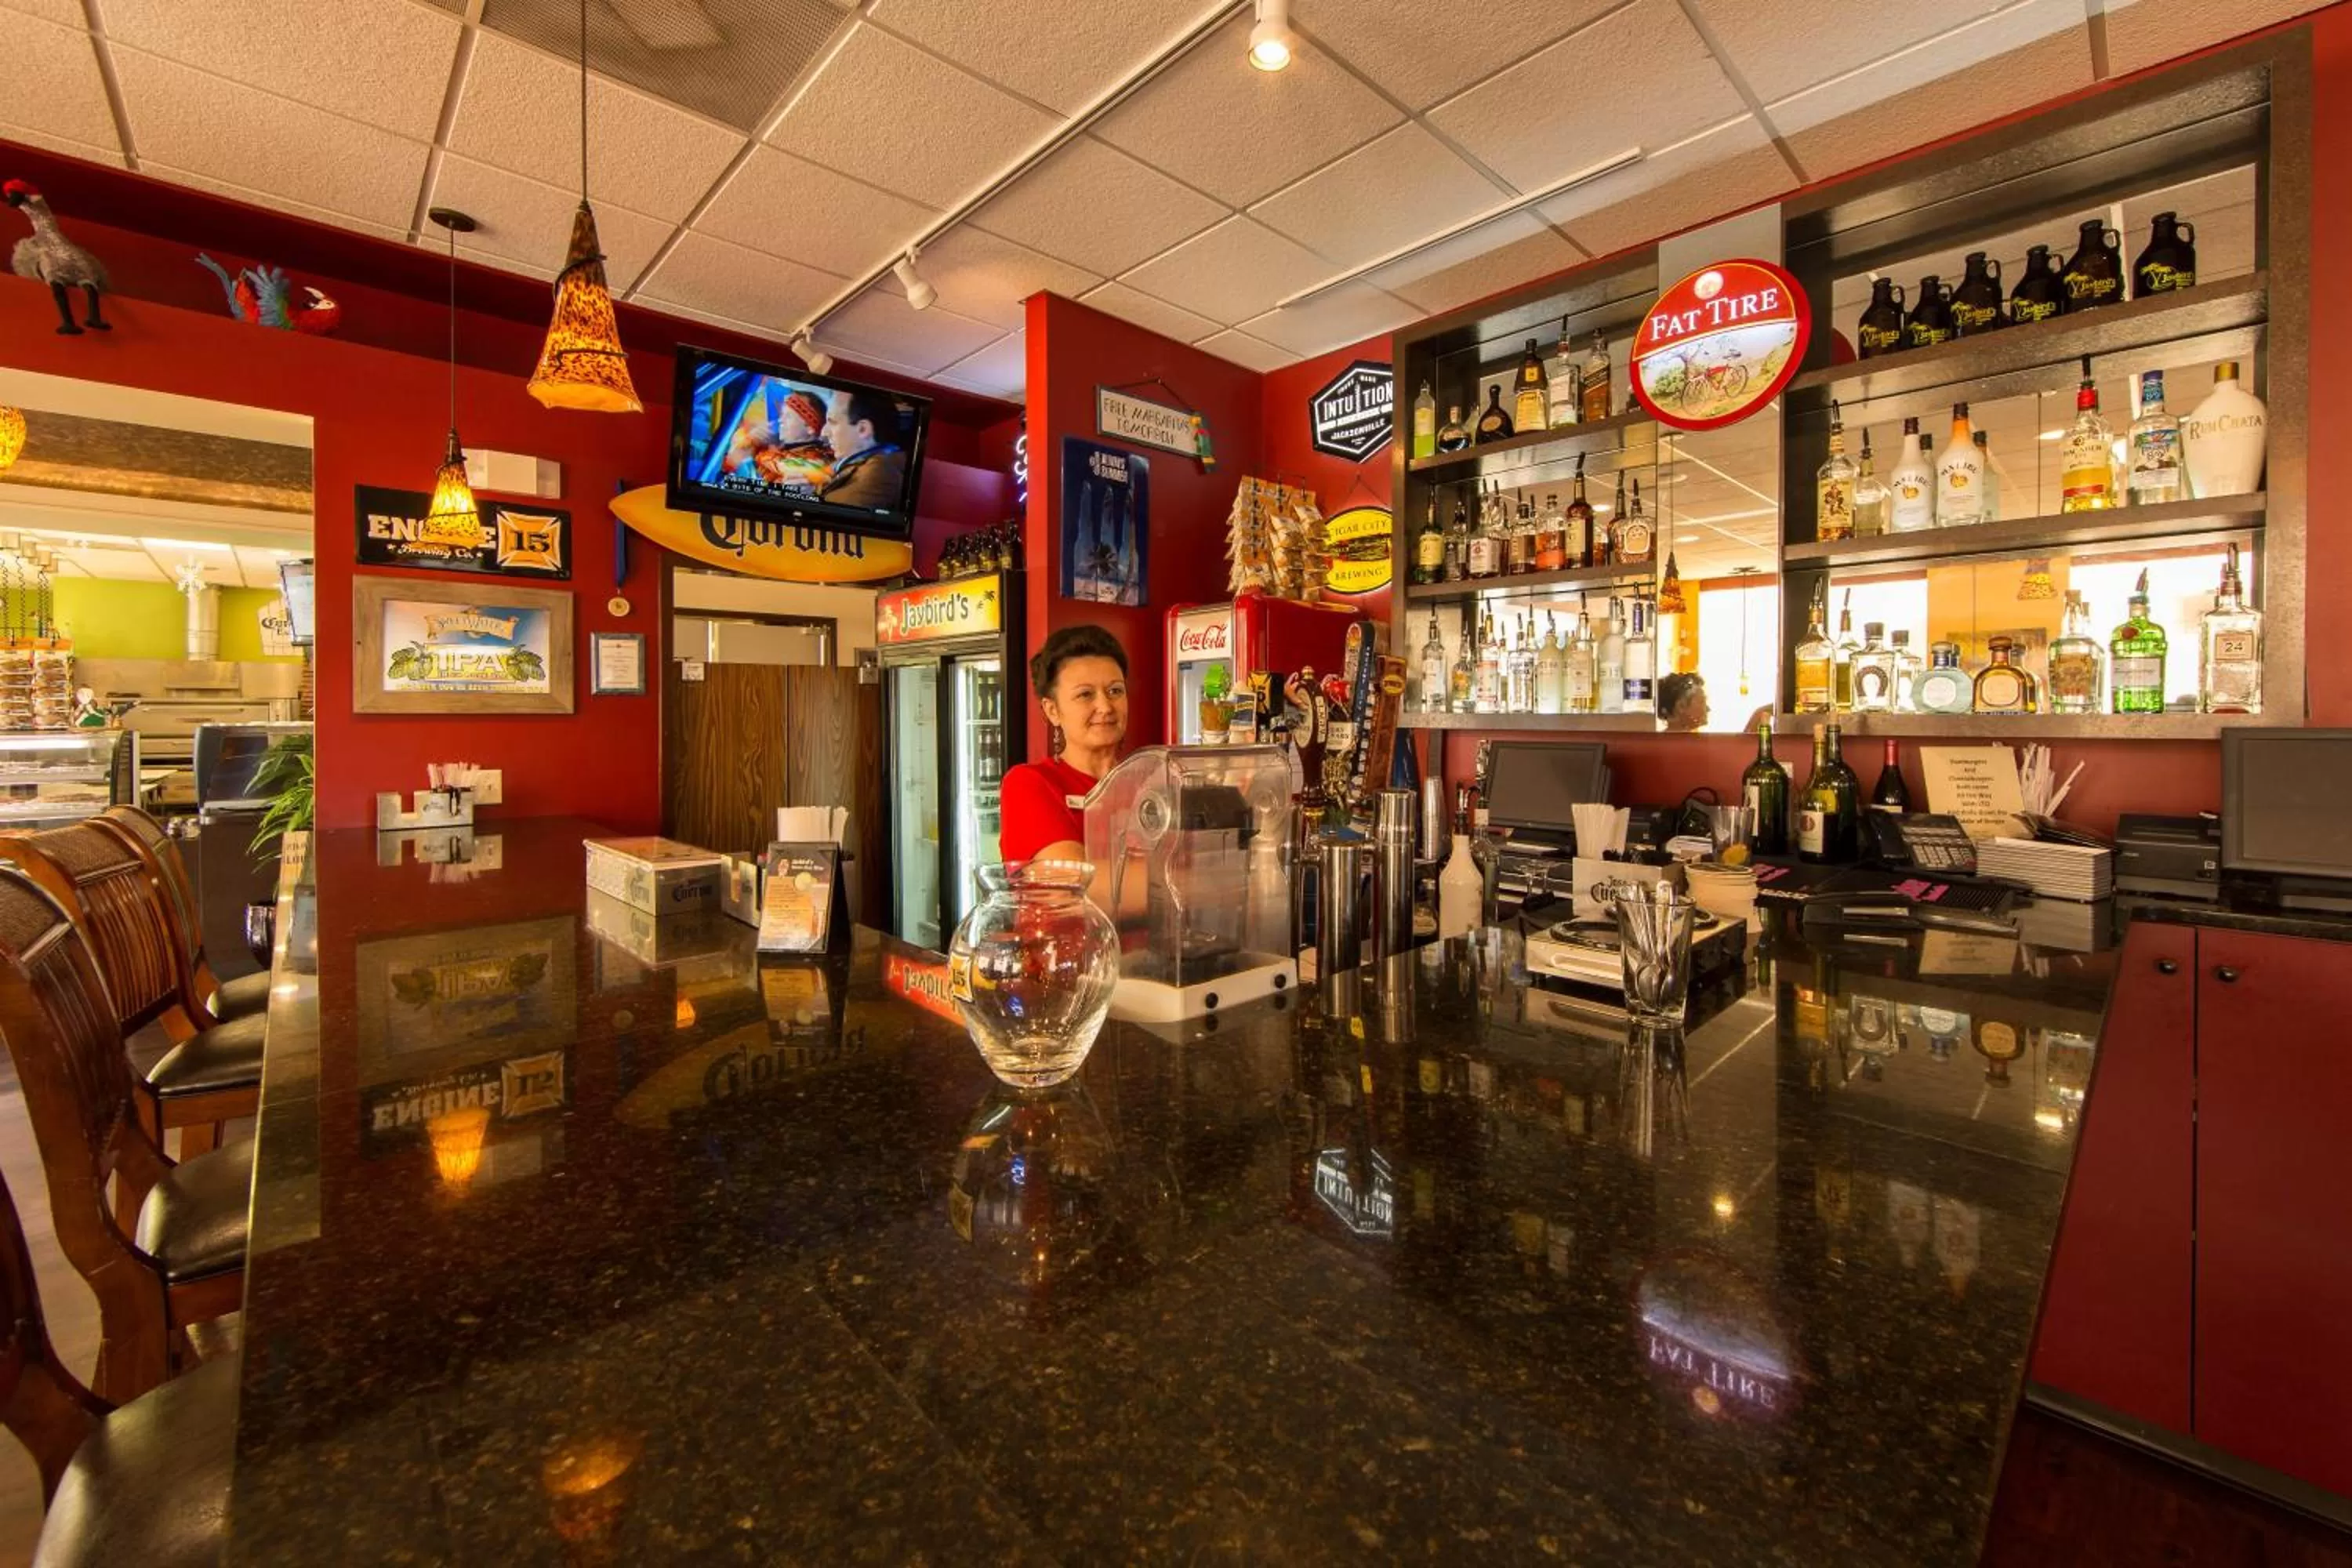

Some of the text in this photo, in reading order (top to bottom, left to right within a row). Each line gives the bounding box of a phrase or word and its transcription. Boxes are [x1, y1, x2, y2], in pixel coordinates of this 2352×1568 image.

[1650, 288, 1779, 342] FAT TIRE
[1323, 379, 1392, 421] INTUITION
[368, 514, 496, 550] ENE
[514, 530, 550, 552] 15
[902, 593, 969, 634] Jaybird's
[438, 648, 503, 673] IPA
